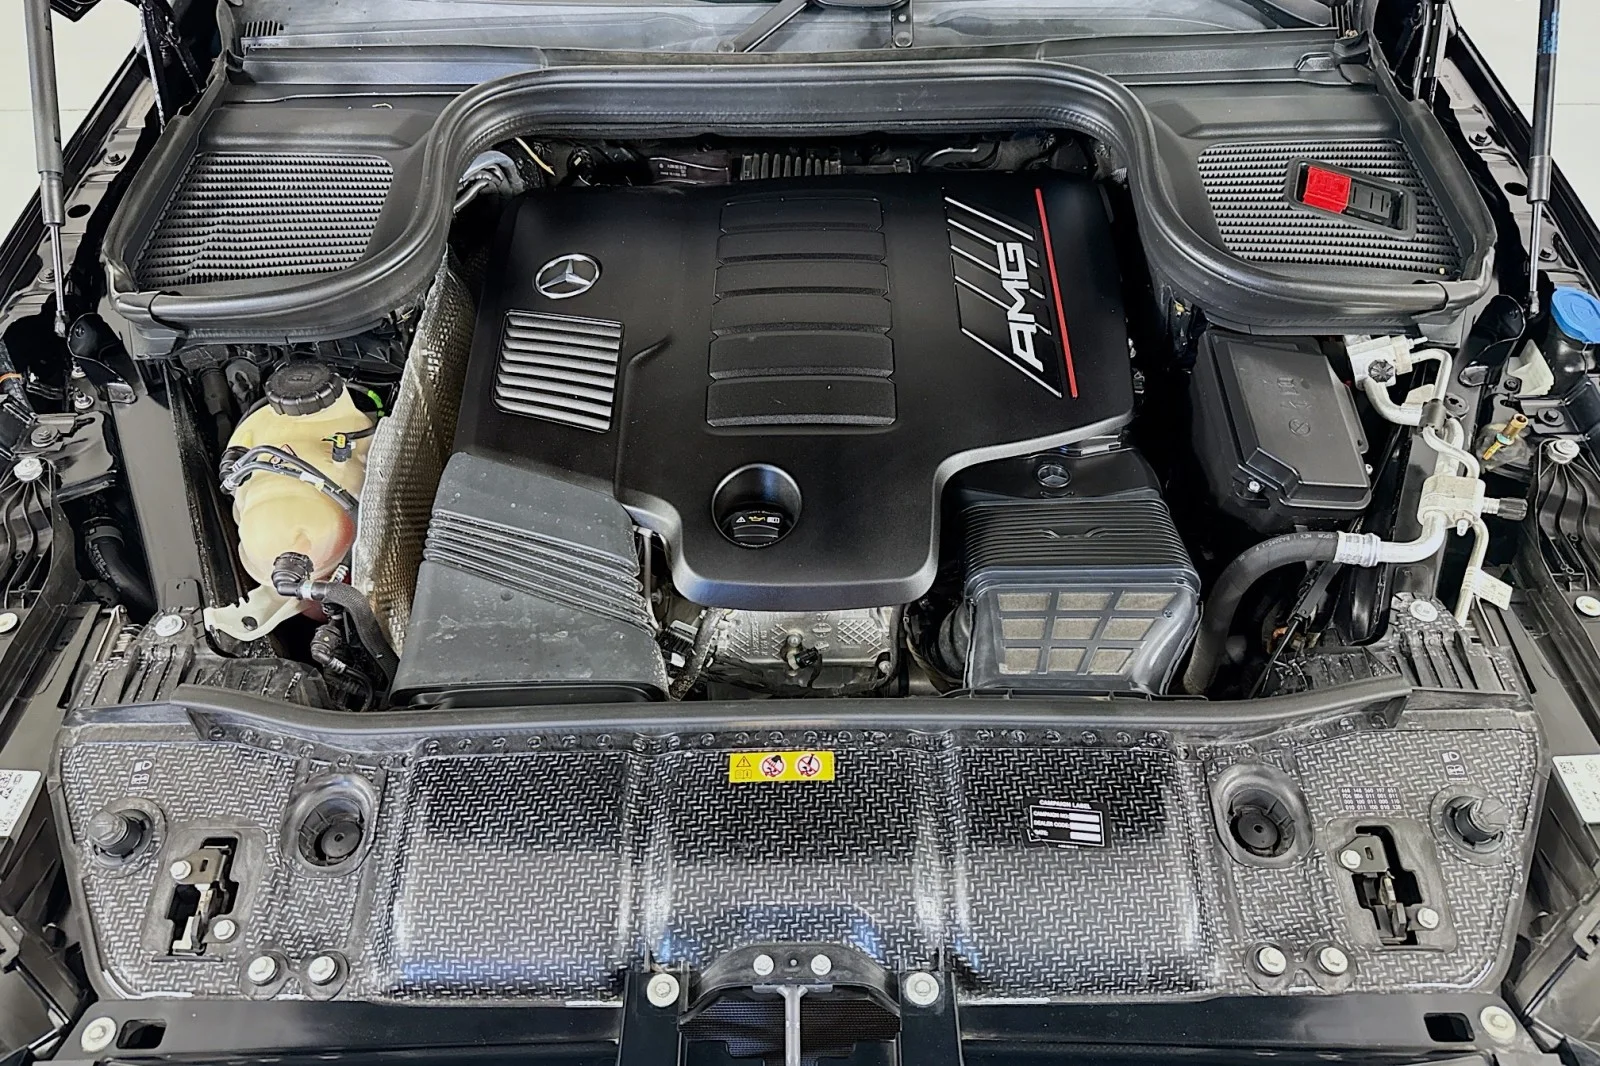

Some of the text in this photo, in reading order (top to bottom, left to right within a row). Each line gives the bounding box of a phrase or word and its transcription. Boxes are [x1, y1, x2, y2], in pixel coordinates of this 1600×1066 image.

[997, 242, 1044, 372] AMG
[1038, 799, 1092, 810] CAMPAIGN LABEL
[1033, 819, 1053, 827] DEALER
